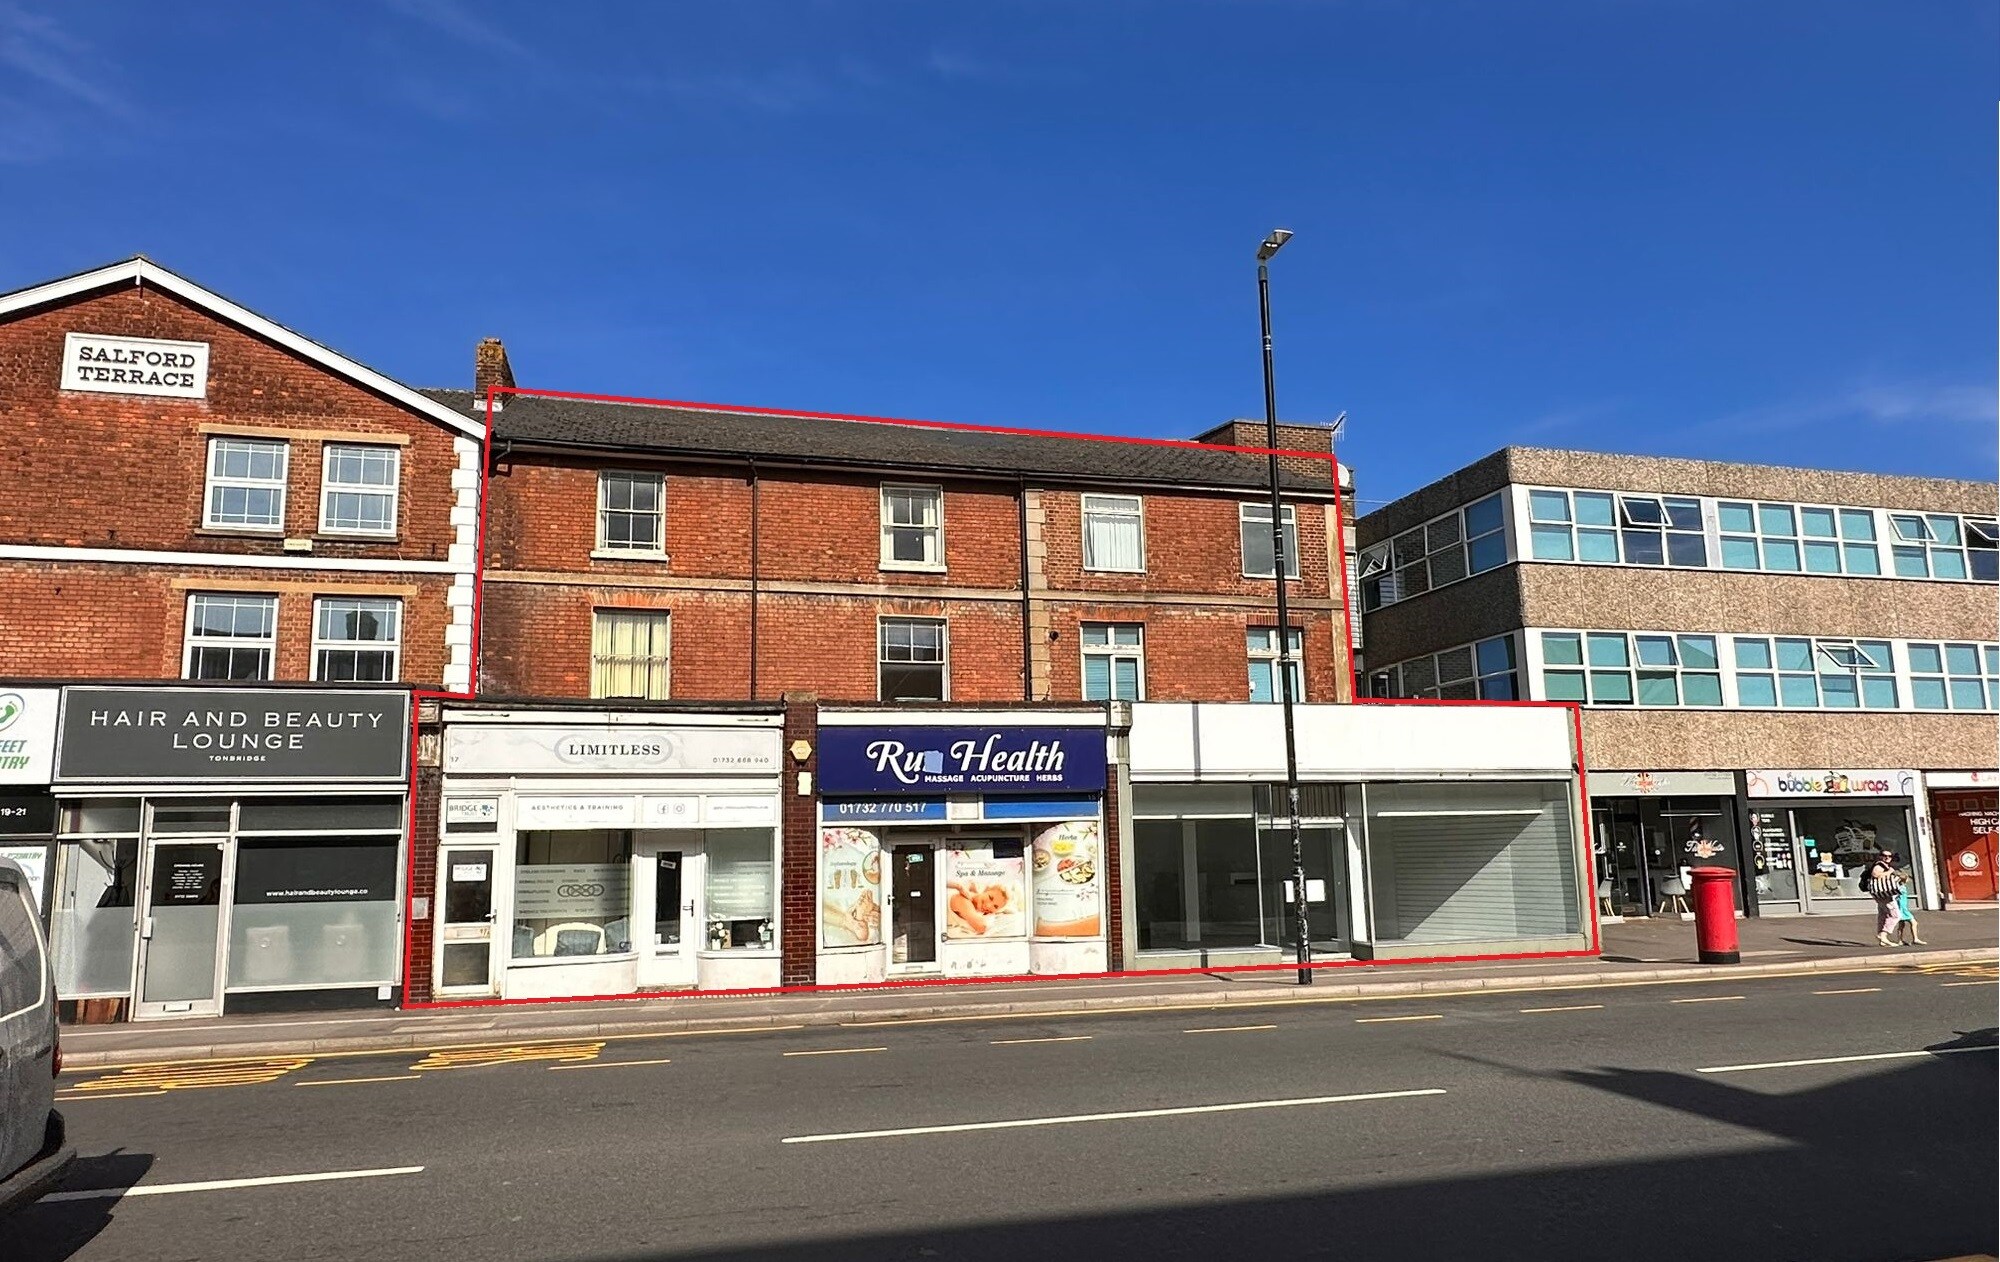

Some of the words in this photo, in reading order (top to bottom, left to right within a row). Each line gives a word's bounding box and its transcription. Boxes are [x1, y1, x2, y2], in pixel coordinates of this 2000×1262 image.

[79, 346, 195, 368] SALFORD
[78, 366, 194, 388] TERRACE
[90, 710, 167, 727] HAIR
[183, 711, 247, 727] AND
[264, 712, 383, 728] BEAUTY
[173, 733, 304, 749] LOUNGE
[569, 744, 661, 756] LIMITLESS
[0, 756, 30, 769] TRY
[866, 741, 943, 784] Ru
[950, 733, 1064, 772] Health
[924, 774, 964, 783] MASSAGE
[970, 774, 1030, 782] ACUPUNCTURE
[1036, 773, 1063, 782] HERBS
[1778, 776, 1822, 792] bubble
[1851, 779, 1889, 794] wraps
[1, 807, 27, 816] 19-21
[449, 804, 477, 812] BRIDGE
[840, 803, 877, 814] 01732
[881, 803, 902, 813] 770
[905, 802, 926, 813] 517
[1970, 818, 1990, 826] HIGH
